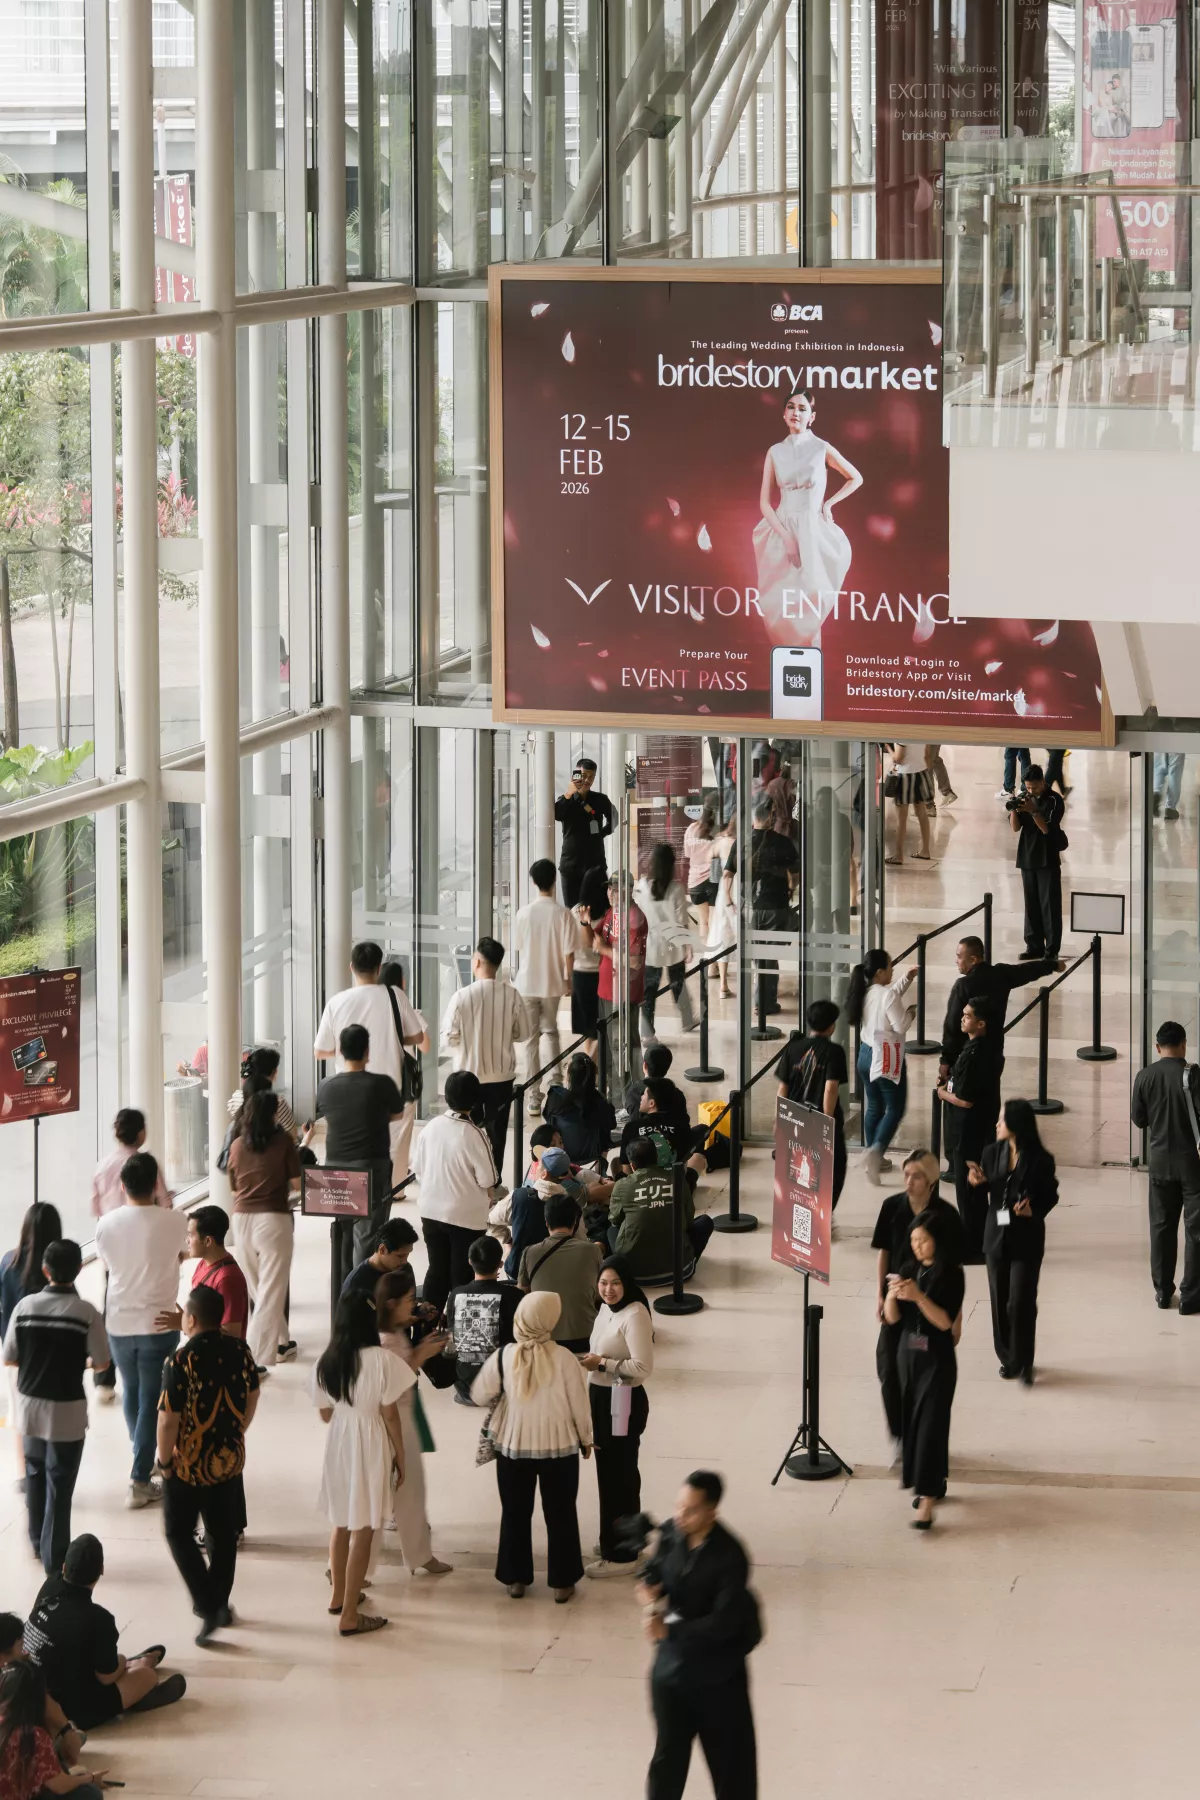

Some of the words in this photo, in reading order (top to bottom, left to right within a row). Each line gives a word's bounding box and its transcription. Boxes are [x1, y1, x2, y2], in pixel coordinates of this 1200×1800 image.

[885, 10, 907, 22] FEB
[935, 64, 956, 73] Win
[958, 64, 998, 73] Various
[888, 82, 976, 100] EXCITING
[983, 82, 1040, 99] PRZES
[894, 108, 907, 120] by
[909, 108, 947, 120] Making
[1017, 106, 1039, 117] with
[901, 129, 954, 141] bridestory
[1137, 147, 1169, 157] Layanan
[1119, 159, 1157, 168] Undangan
[1129, 171, 1155, 179] Mudah
[1119, 200, 1170, 228] 500
[1139, 247, 1153, 256] A17
[1154, 247, 1169, 256] A19
[789, 304, 823, 321] BCA
[691, 340, 708, 349] The
[710, 341, 747, 351] Leading
[750, 341, 792, 352] Wedding
[795, 342, 843, 351] Exhibition
[846, 342, 855, 351] in
[858, 343, 904, 352] Indonesia
[560, 448, 604, 475] FEB
[560, 481, 590, 495] 2026
[628, 583, 765, 617] VISITOR
[781, 588, 967, 625] ENTRANC
[679, 649, 722, 661] Prepare
[724, 650, 748, 660] Your
[846, 654, 900, 666] Download
[903, 657, 912, 666] &
[914, 657, 945, 669] Login
[949, 658, 960, 668] to
[621, 667, 690, 689] EVENT
[699, 668, 748, 691] PASS
[785, 673, 806, 683] bride
[846, 668, 903, 681] Bridestory
[906, 670, 928, 682] App
[931, 672, 944, 681] or
[946, 671, 972, 682] Visit
[789, 680, 808, 690] story
[846, 683, 1026, 703] bridestory.com/site/market
[2, 1013, 38, 1026] EXCLUSIVE
[39, 1008, 72, 1020] PRIVILEGE
[648, 1199, 665, 1209] JPN
